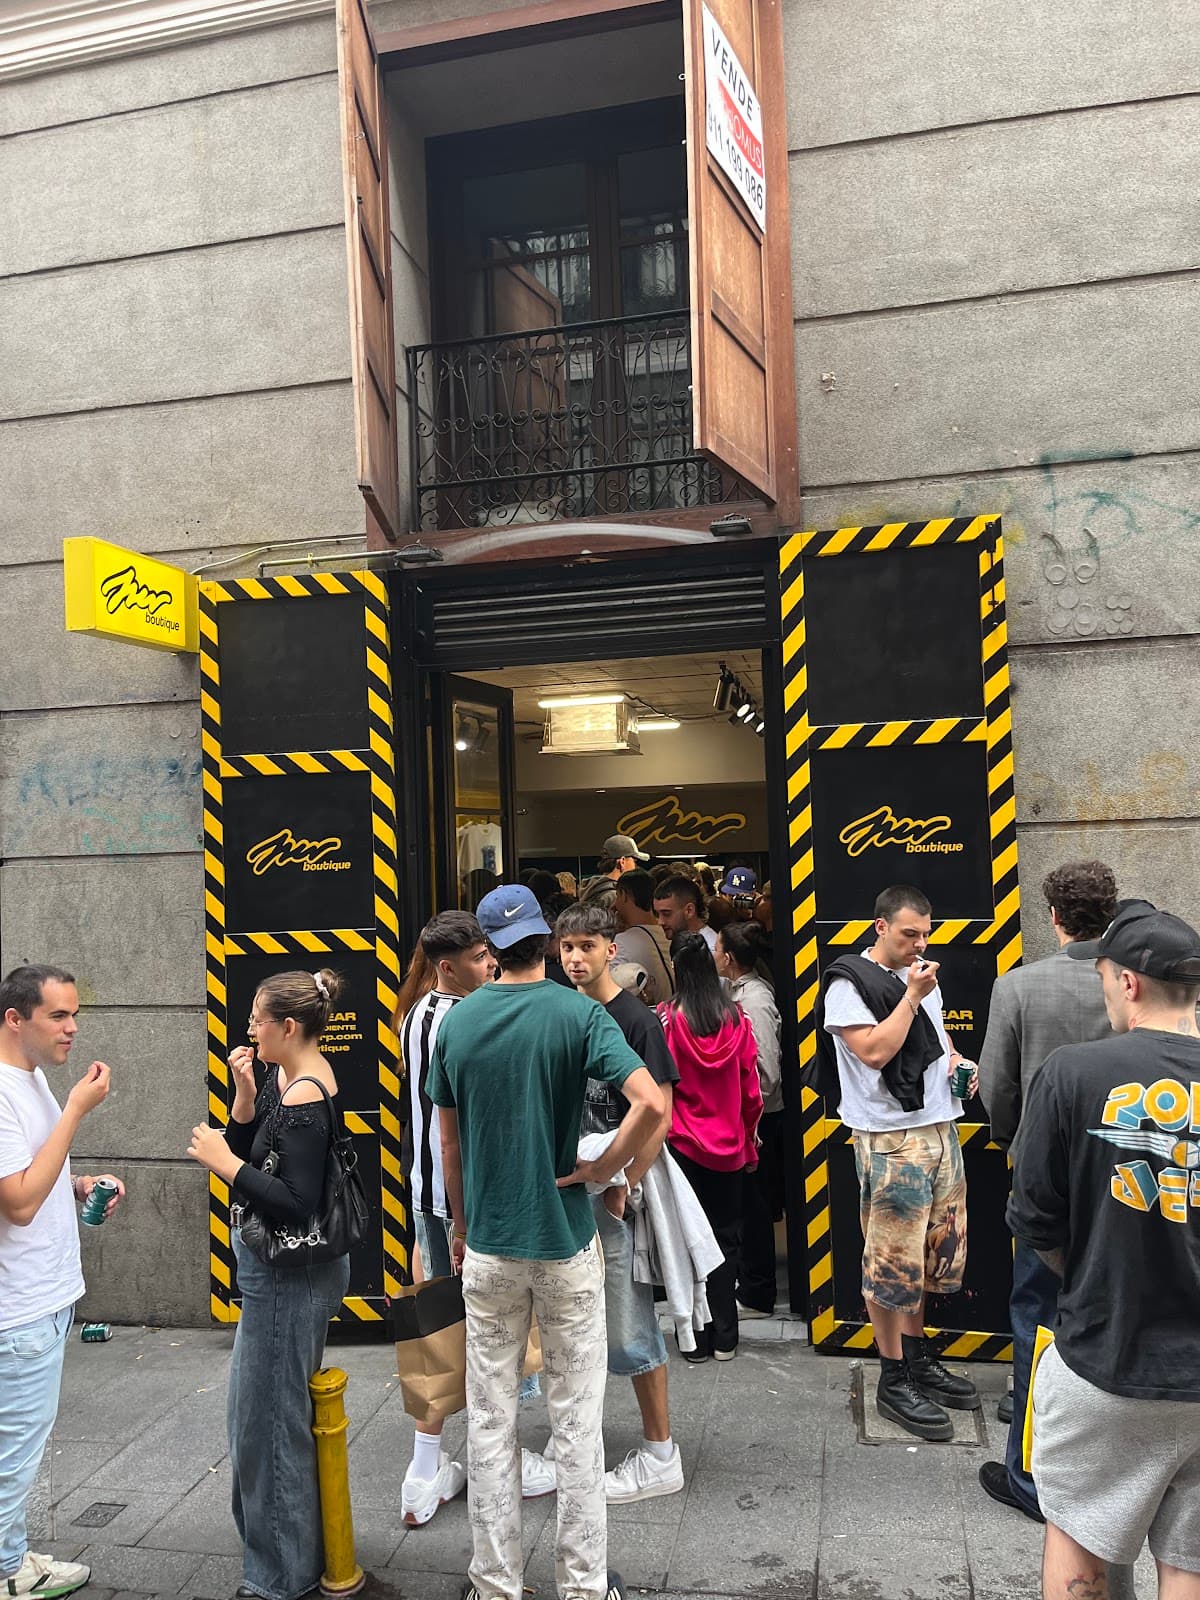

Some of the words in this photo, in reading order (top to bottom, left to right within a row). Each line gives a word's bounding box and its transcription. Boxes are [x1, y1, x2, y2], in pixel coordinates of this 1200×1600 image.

[711, 26, 753, 121] VENDE
[726, 138, 743, 182] 199
[745, 167, 763, 210] 086
[145, 611, 180, 633] boutique
[905, 841, 964, 855] boutique
[302, 860, 352, 872] boutique
[941, 1009, 974, 1020] EAR
[943, 1023, 974, 1031] ENTE
[319, 1033, 363, 1042] rp.com
[317, 1044, 351, 1053] tique
